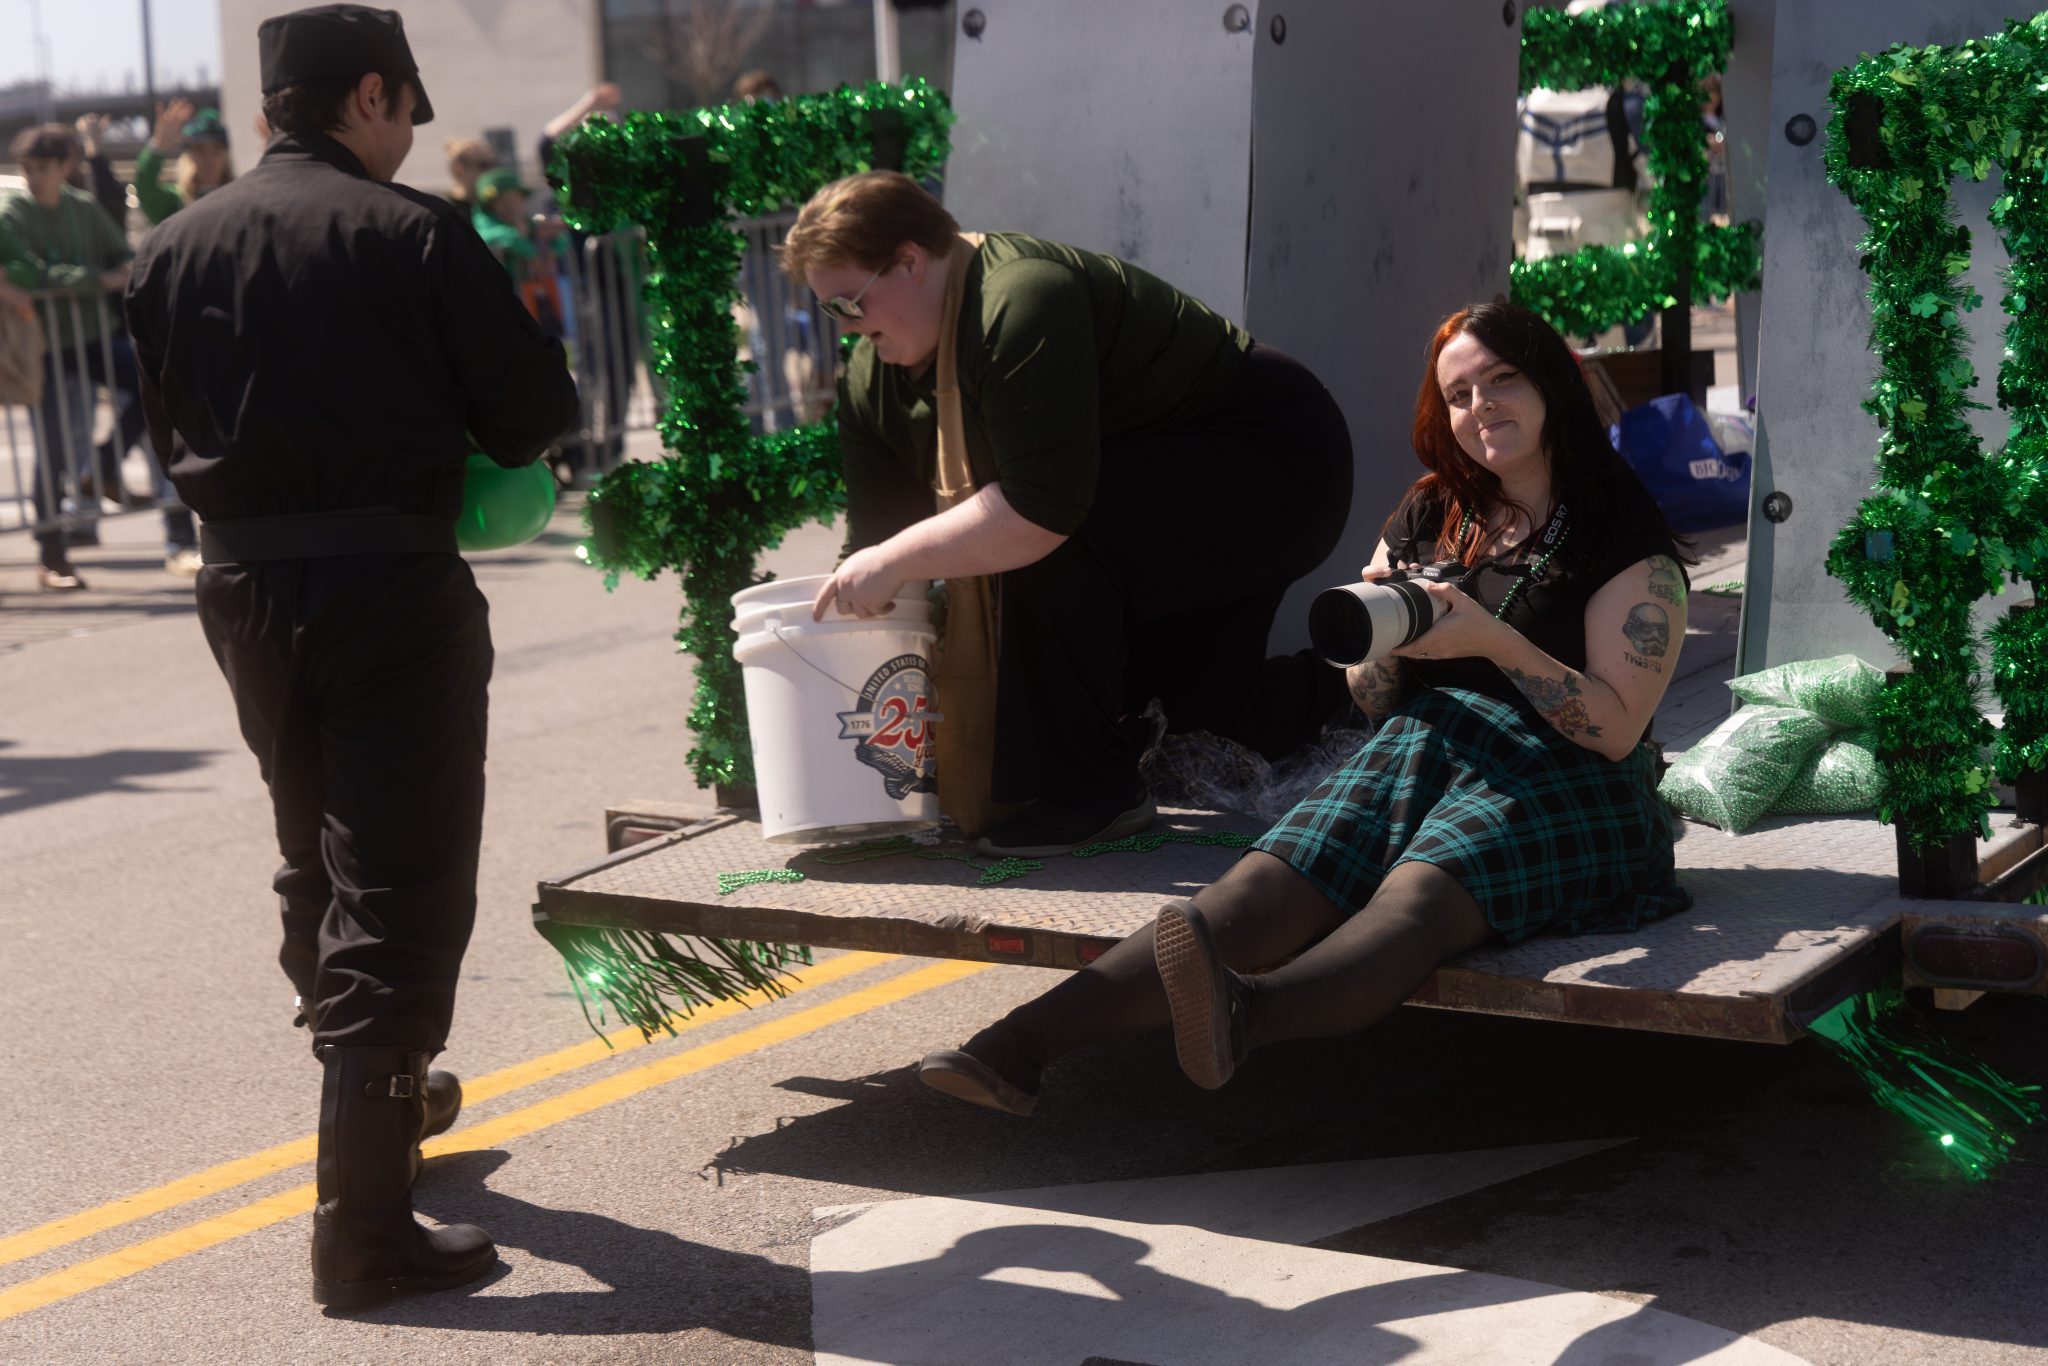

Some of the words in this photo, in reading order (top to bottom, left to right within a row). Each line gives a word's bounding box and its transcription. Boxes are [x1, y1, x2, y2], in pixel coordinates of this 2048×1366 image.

[1543, 517, 1562, 544] EOS
[1555, 504, 1568, 519] R7
[864, 667, 890, 699] UNITED
[891, 656, 917, 671] STATES
[850, 719, 871, 729] 1776
